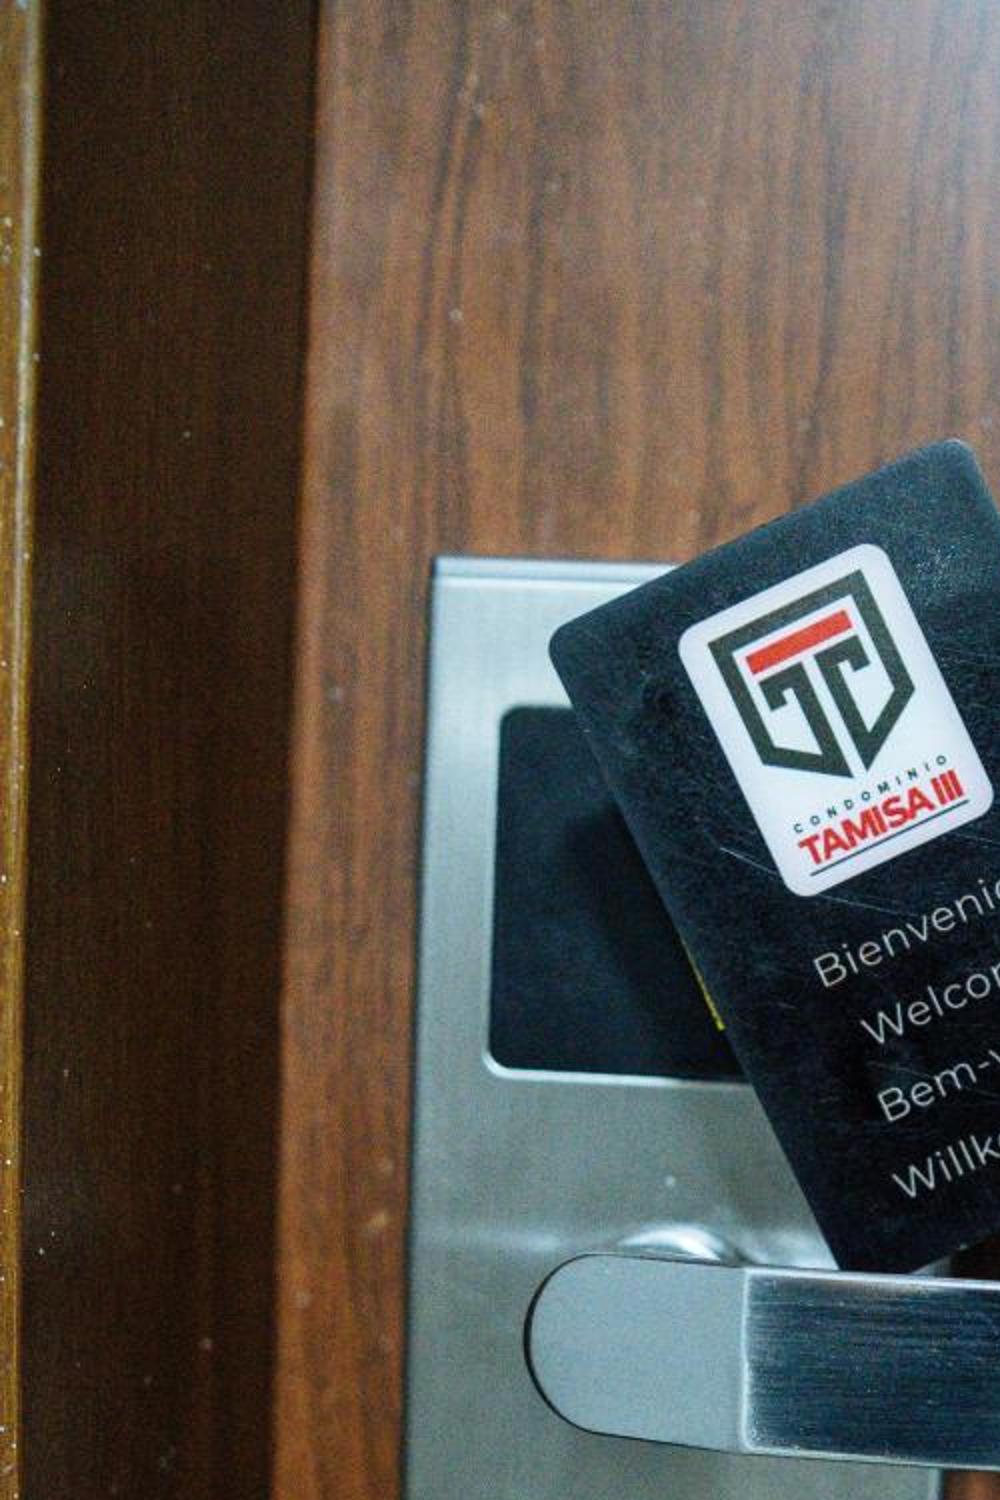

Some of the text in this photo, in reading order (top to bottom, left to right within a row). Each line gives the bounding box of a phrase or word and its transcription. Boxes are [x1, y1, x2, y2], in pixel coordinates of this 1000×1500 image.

[793, 754, 947, 834] CONDOMINIO
[798, 769, 964, 865] TAMISA III
